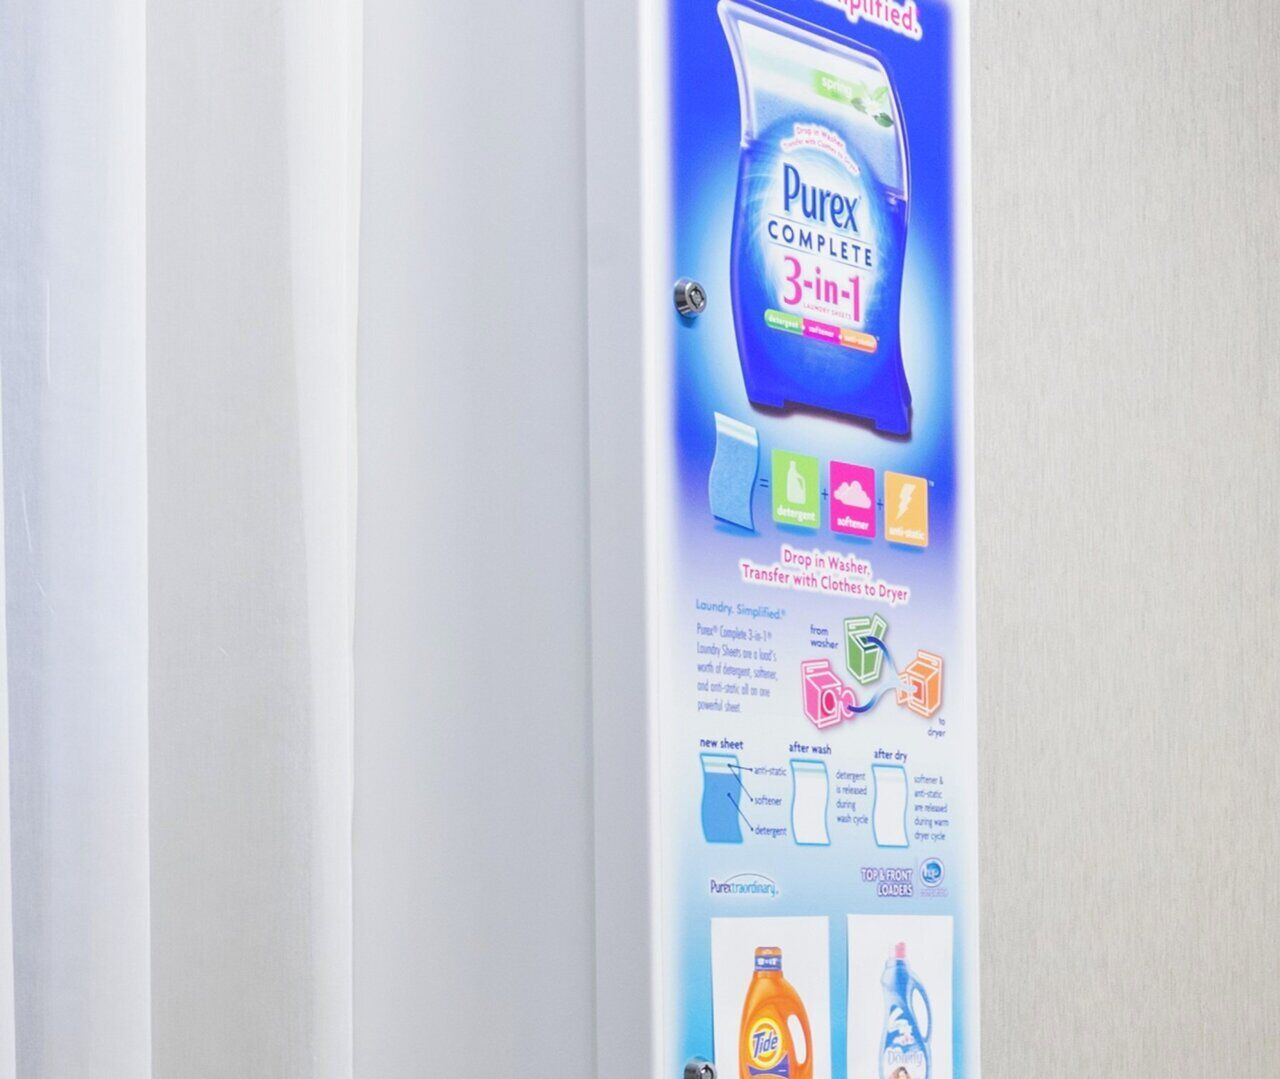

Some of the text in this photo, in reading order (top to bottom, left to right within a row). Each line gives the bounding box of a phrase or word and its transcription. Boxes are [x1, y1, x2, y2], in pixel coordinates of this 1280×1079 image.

[783, 162, 860, 233] Purex
[768, 220, 873, 267] COMPLETE
[783, 255, 860, 322] 3-in-1
[777, 505, 816, 522] detergent
[837, 516, 869, 531] softener
[889, 526, 925, 541] anti-static
[784, 549, 871, 576] Drop in Washer.
[742, 564, 908, 601] Transfer with Clothes to Dryer
[696, 599, 734, 615] Laundry.
[810, 624, 829, 635] from
[810, 638, 839, 649] washer
[938, 718, 946, 726] to
[927, 728, 946, 738] dryer
[700, 738, 744, 750] new sheet
[789, 743, 831, 755] after wash
[874, 749, 908, 762] after dry
[754, 767, 787, 777] anti-static
[836, 771, 865, 783] detergent
[914, 775, 938, 784] softener
[842, 786, 867, 796] released
[754, 795, 782, 806] softener
[836, 800, 856, 812] during
[837, 814, 869, 825] wash cycle
[914, 818, 933, 829] during
[755, 826, 787, 838] detergent
[914, 831, 946, 842] dryer cycle
[861, 867, 878, 882] TOP
[886, 868, 913, 882] FRONT
[877, 882, 914, 897] LOADERS
[753, 1031, 779, 1058] Tide
